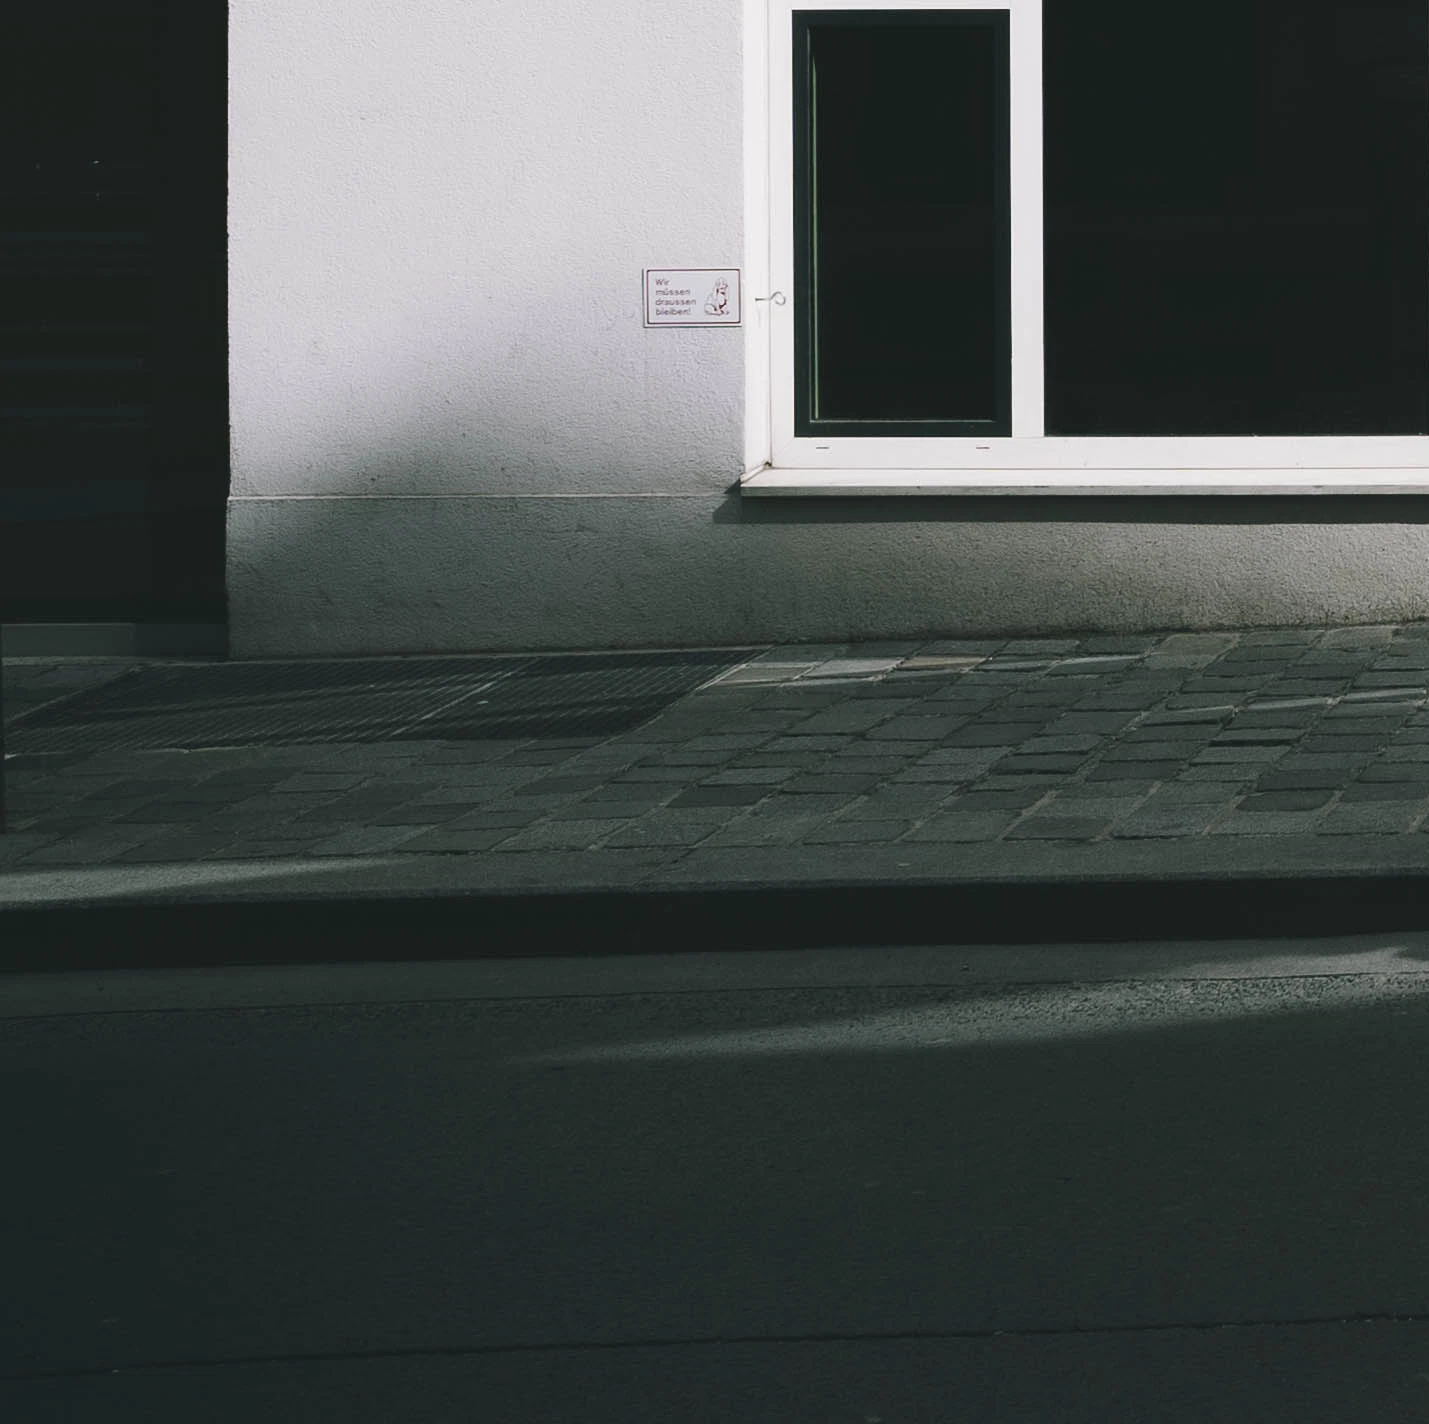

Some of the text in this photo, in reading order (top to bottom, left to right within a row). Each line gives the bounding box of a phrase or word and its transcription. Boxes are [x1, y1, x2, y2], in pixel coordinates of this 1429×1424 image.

[655, 278, 670, 286] Wir
[655, 287, 691, 296] müssen
[655, 297, 697, 306] draussen
